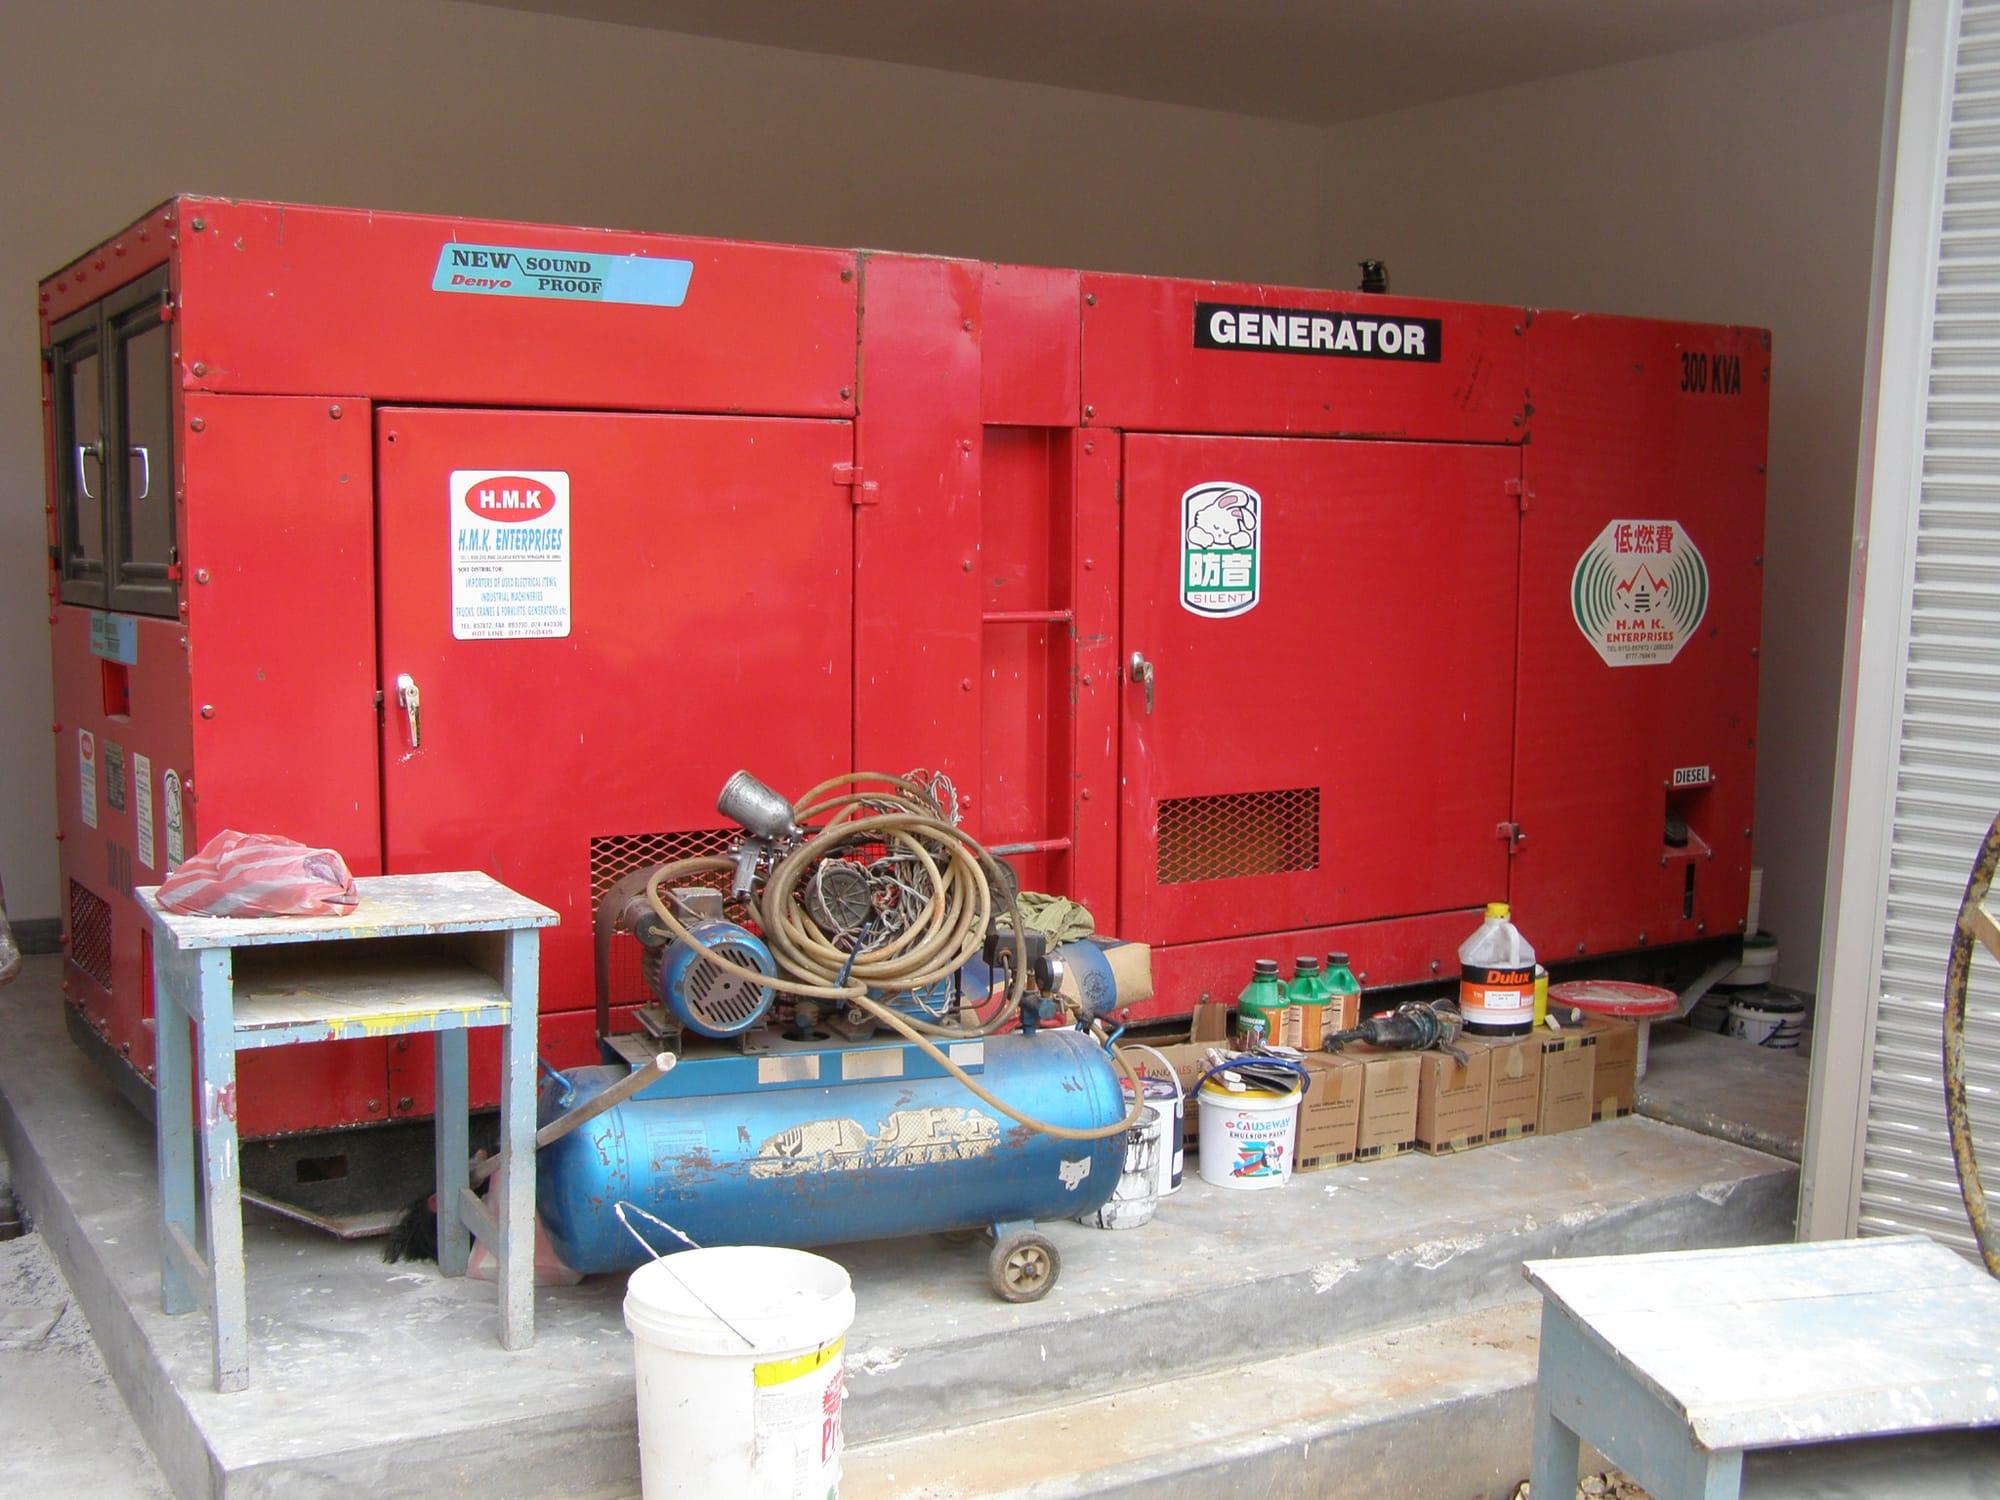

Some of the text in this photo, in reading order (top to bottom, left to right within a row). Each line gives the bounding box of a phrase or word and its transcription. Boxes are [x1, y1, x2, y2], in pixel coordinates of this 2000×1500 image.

[452, 250, 591, 273] NEW SOUND
[451, 274, 512, 289] Denyo
[538, 278, 602, 294] PROOF
[1210, 311, 1425, 355] GENERATOR
[1681, 352, 1741, 394] 300 KVA
[480, 490, 542, 509] H.M.K
[458, 528, 563, 551] H.M.K. ENTERPRISES
[1614, 524, 1673, 554] 低燃費
[1189, 553, 1252, 587] 防音
[465, 578, 493, 588] IMPORTERS
[494, 578, 500, 588] OF
[501, 578, 514, 588] USED
[515, 577, 541, 588] ELECTRICAL
[481, 591, 543, 602] INDUSTRIAL MACHINERIES
[1194, 593, 1246, 603] SILENT
[476, 606, 495, 617] CRANES
[528, 605, 558, 616] GENERATORS
[1606, 632, 1674, 642] ENTERPRISES
[1675, 768, 1706, 784] DIESEL
[1487, 970, 1531, 984] Dulux
[1236, 1117, 1291, 1131] CAUSEWAY
[1229, 1130, 1287, 1140] EMULSION PAINT
